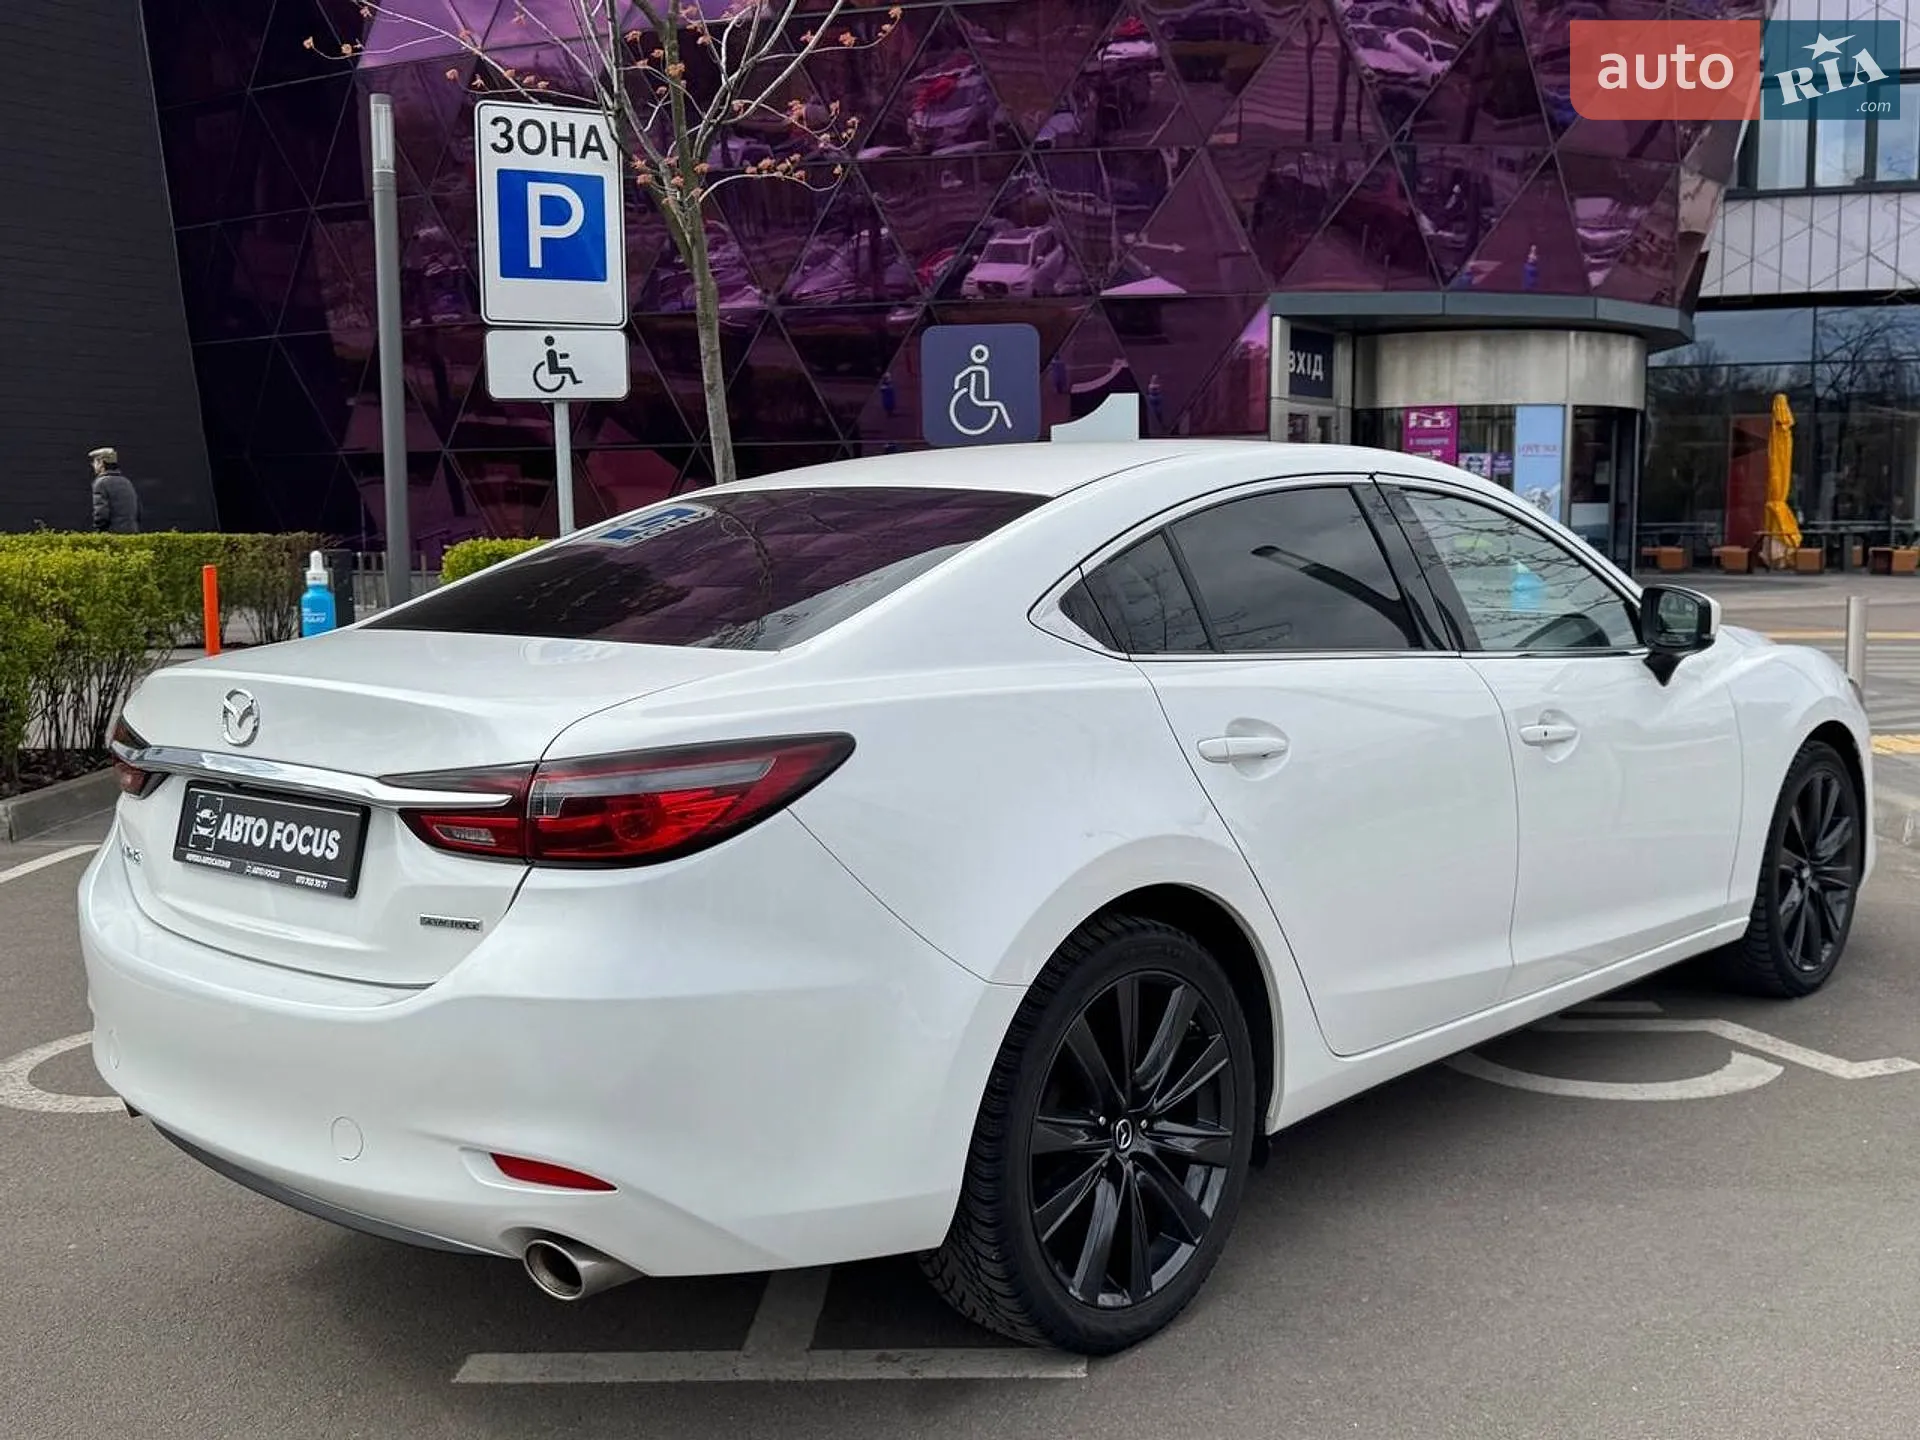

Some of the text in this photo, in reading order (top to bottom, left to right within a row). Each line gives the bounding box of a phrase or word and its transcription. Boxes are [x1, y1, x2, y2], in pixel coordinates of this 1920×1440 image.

[490, 115, 608, 161] ЗОНА
[527, 181, 585, 269] P
[217, 812, 341, 861] АВТО FOCUS
